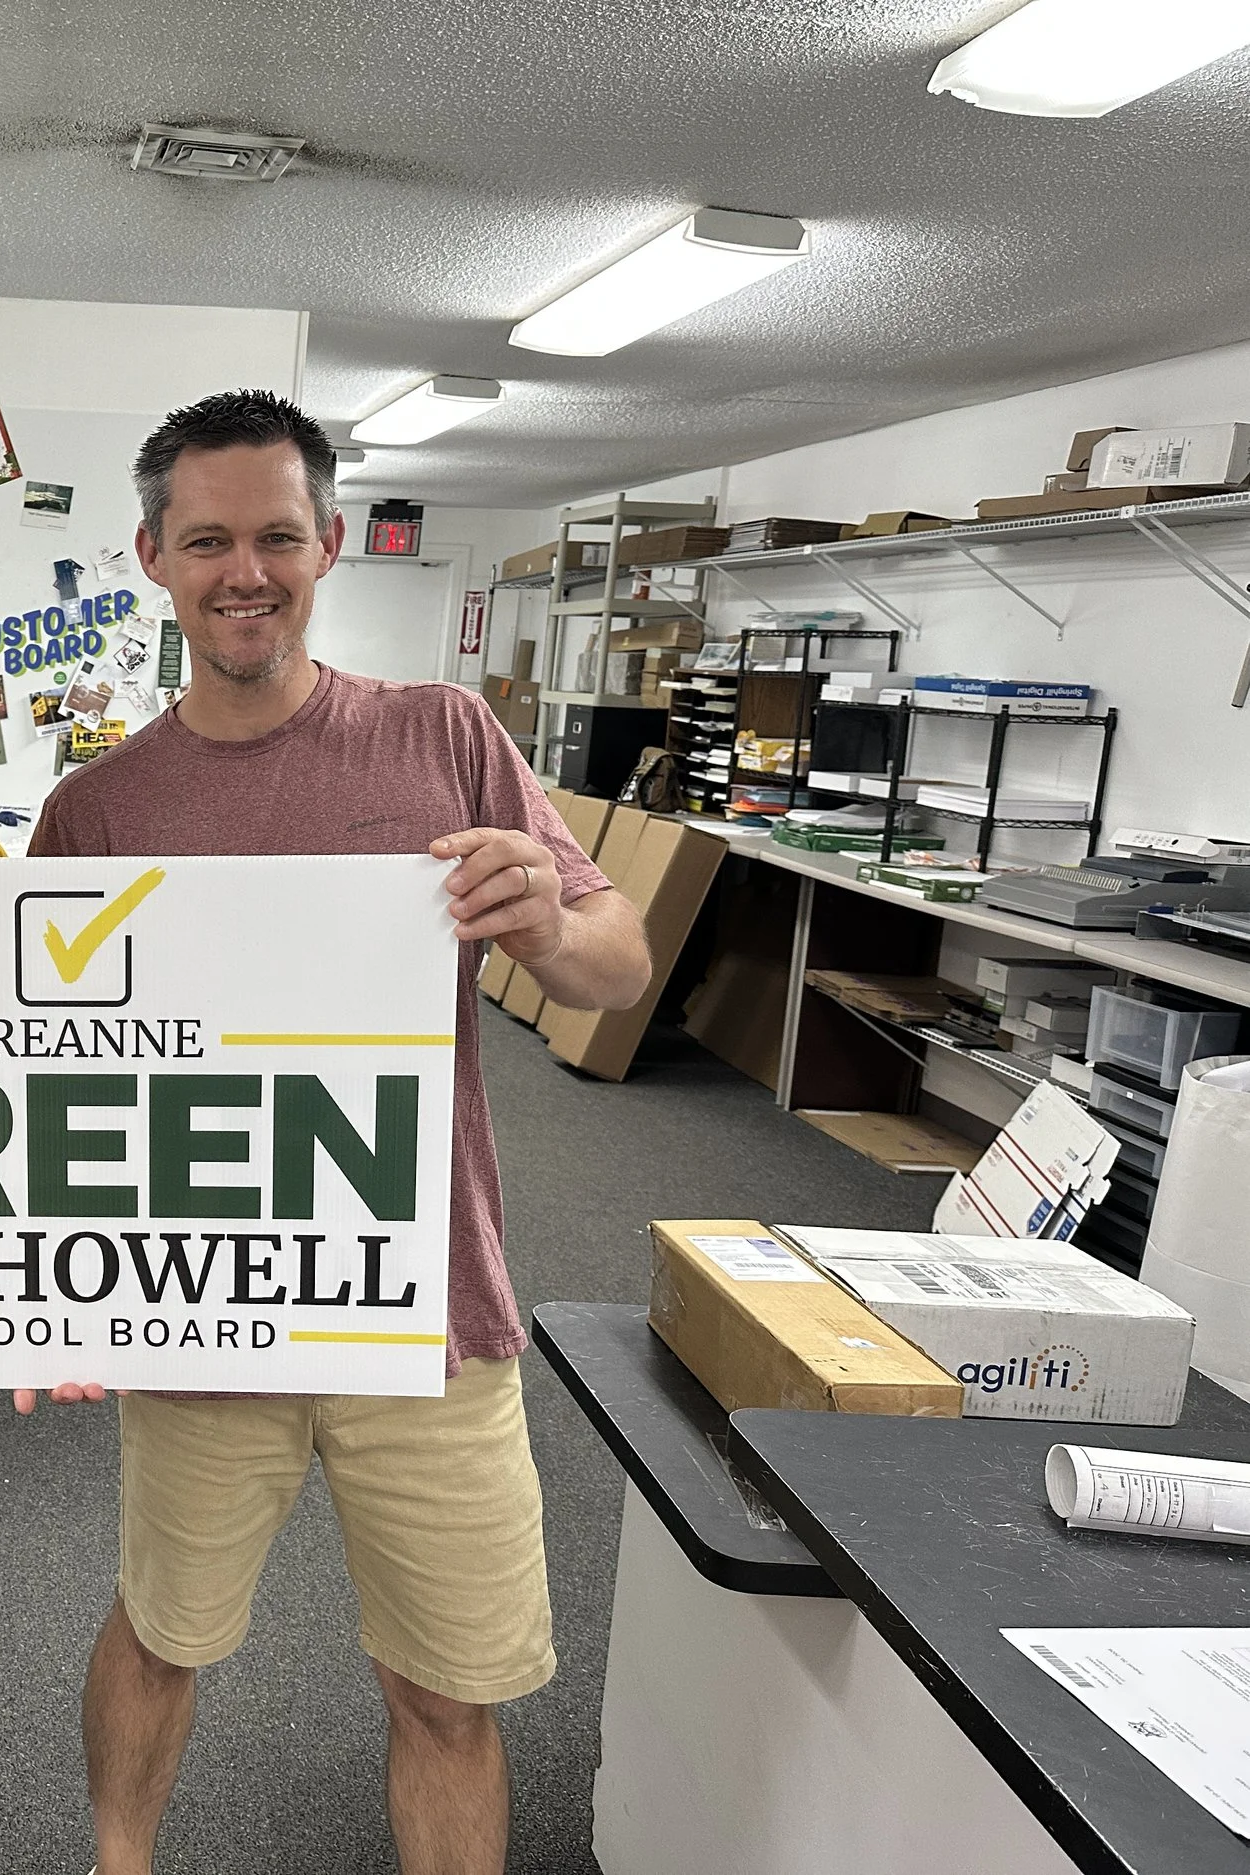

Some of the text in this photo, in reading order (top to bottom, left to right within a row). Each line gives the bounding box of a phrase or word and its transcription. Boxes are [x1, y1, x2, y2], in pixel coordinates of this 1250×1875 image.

[373, 524, 417, 552] EXIT
[4, 629, 105, 677] BOARD
[1017, 686, 1083, 697] Springhill Digital
[111, 1317, 277, 1350] BOARD
[957, 1357, 1070, 1393] agiliti
